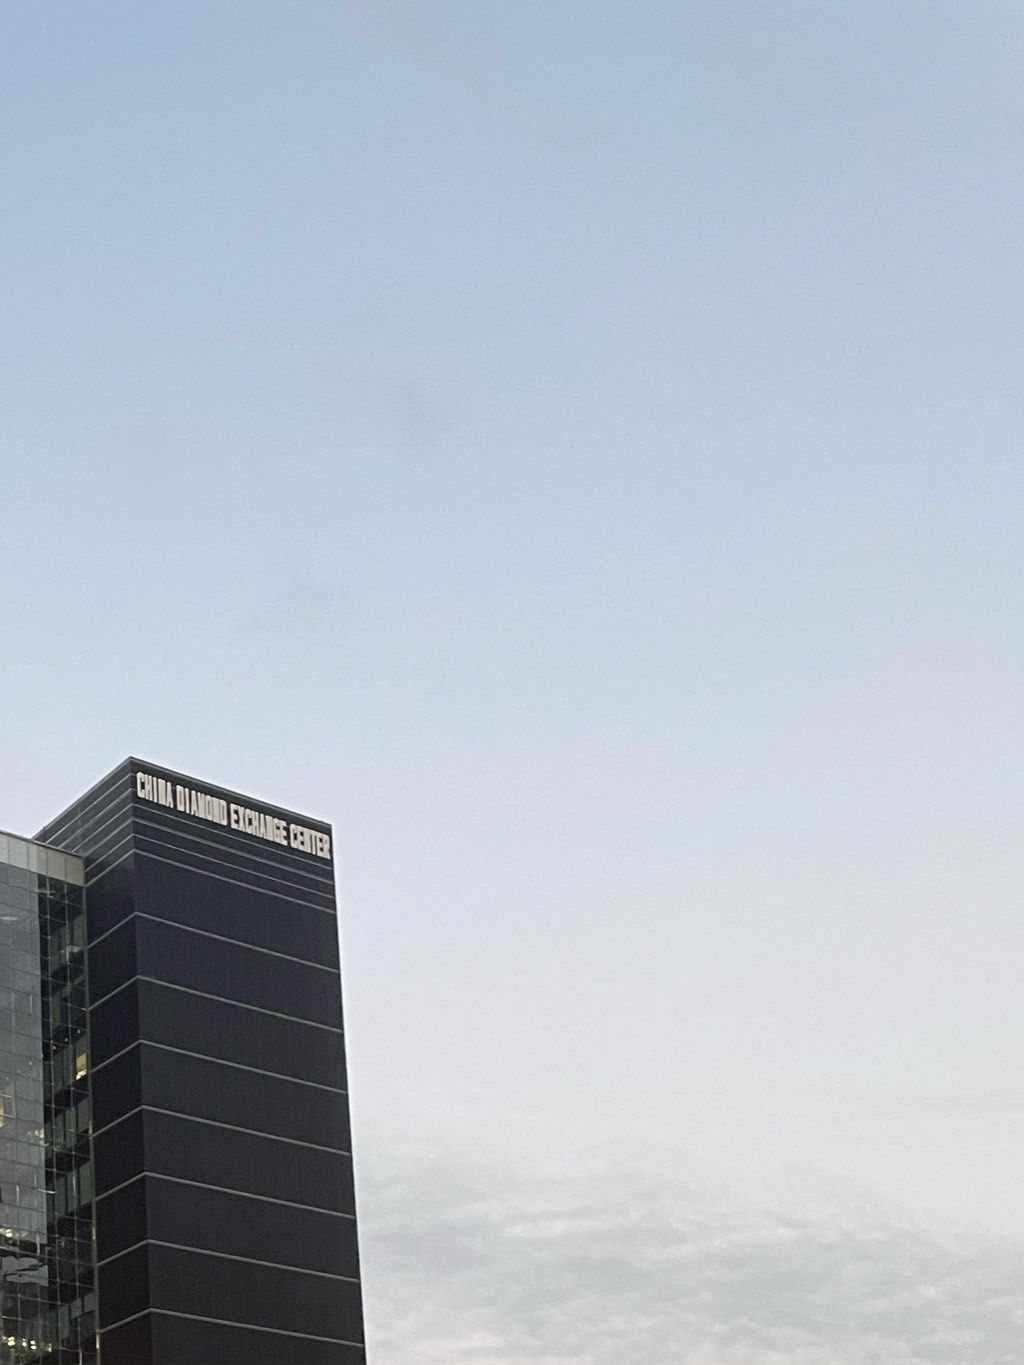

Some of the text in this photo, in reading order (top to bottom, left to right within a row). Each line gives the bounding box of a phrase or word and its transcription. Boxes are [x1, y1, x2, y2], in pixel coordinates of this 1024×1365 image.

[136, 771, 331, 859] CHINA DIAMOND EXCHANGE CENTER
